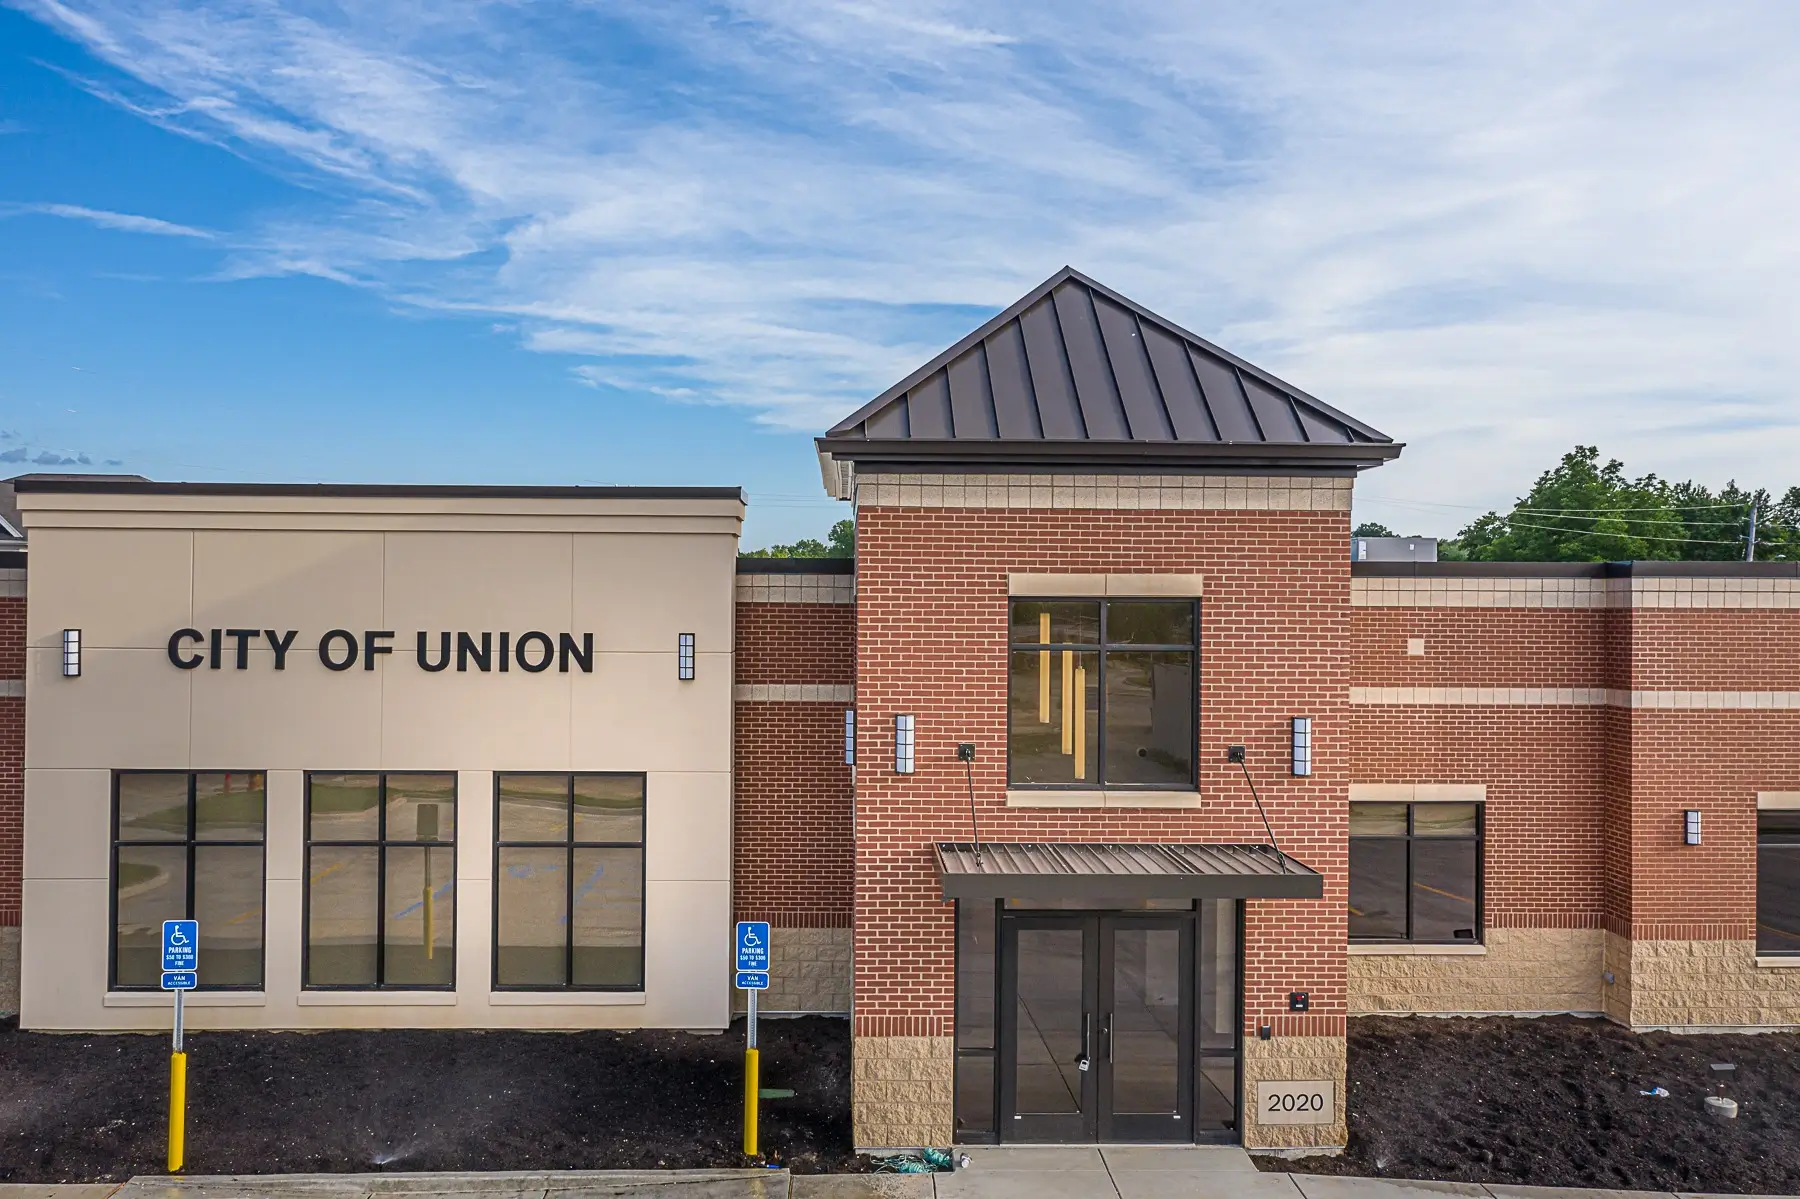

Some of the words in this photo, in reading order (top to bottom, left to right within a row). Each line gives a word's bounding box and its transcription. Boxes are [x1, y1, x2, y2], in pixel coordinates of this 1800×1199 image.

[168, 629, 298, 670] CITY
[318, 630, 395, 671] OF
[417, 632, 594, 672] UNION
[1267, 1093, 1324, 1112] 2020
